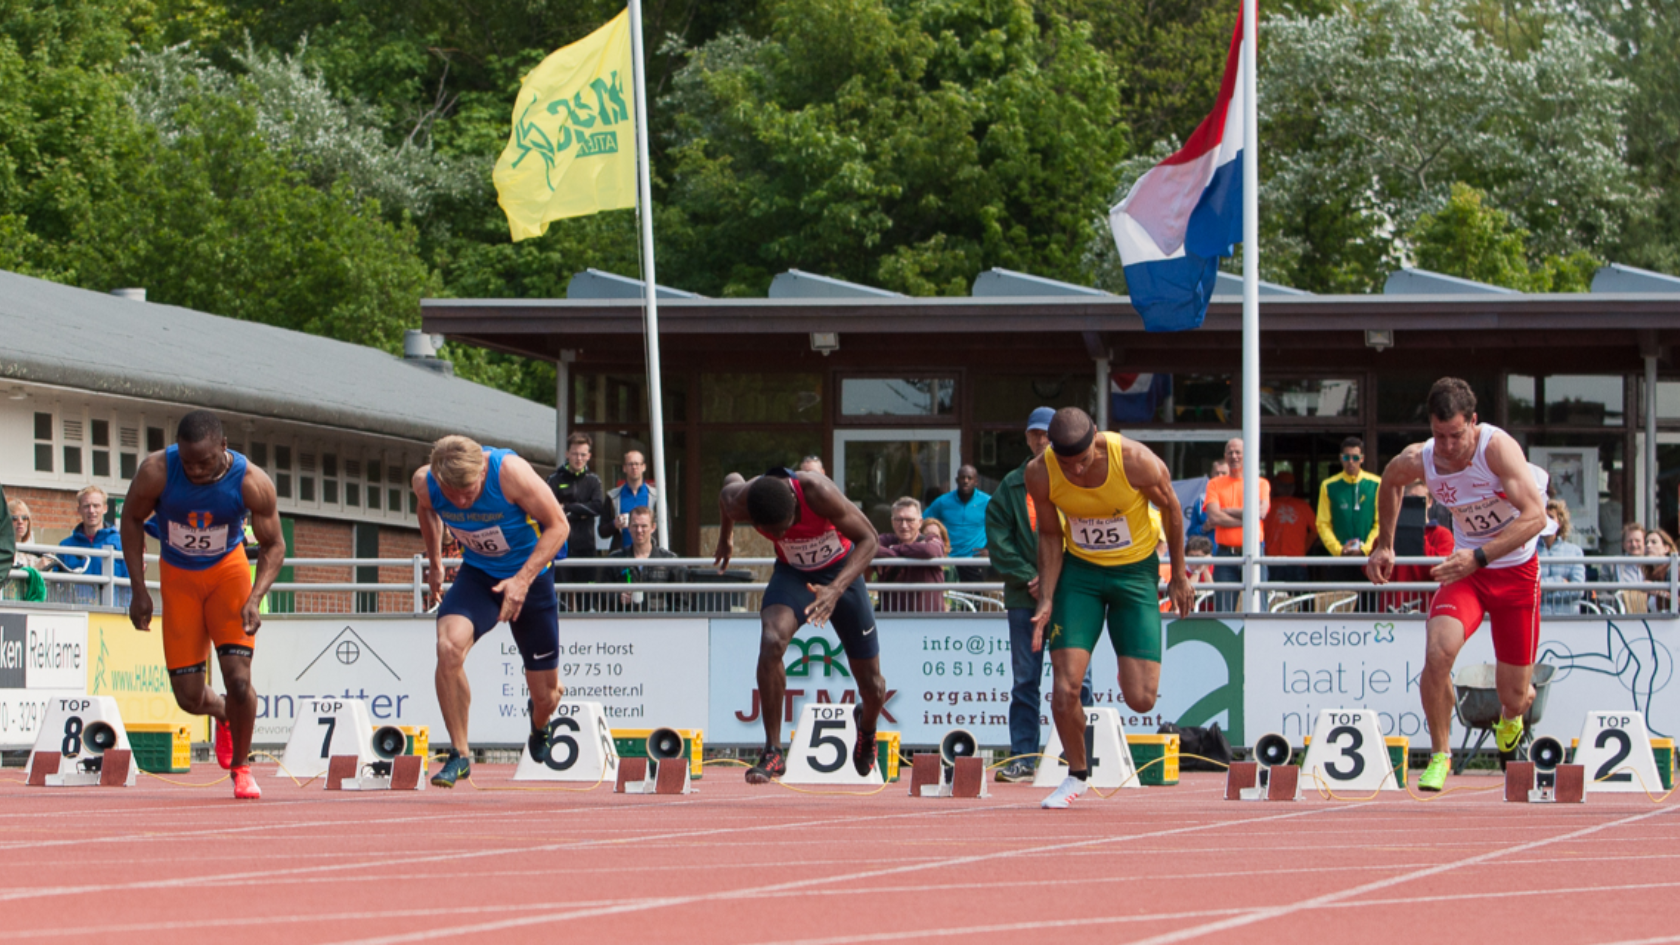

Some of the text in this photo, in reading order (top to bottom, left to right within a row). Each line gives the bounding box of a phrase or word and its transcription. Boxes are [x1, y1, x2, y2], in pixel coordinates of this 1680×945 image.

[1465, 510, 1502, 531] 131
[184, 534, 212, 549] 25
[1081, 528, 1120, 545] 125
[795, 546, 832, 565] 173
[1282, 625, 1372, 647] xcelsior
[30, 629, 81, 669] Reklame
[569, 641, 593, 655] der
[597, 642, 634, 655] Horst
[562, 663, 580, 676] 97
[584, 663, 601, 676] 75
[606, 663, 623, 676] 10
[922, 661, 946, 676] 06
[983, 661, 1006, 676] 64
[1281, 661, 1349, 695] laat
[1353, 660, 1392, 701] je
[60, 699, 91, 712] TOP
[311, 701, 343, 714] TOP
[811, 707, 845, 720] TOP
[1329, 713, 1362, 726] TOP
[1596, 715, 1631, 728] TOP
[62, 716, 83, 758] 8
[318, 717, 336, 758] 7
[545, 717, 581, 771] 6
[806, 720, 848, 773] 5
[1324, 726, 1365, 781] 3
[1594, 729, 1633, 782] 2
